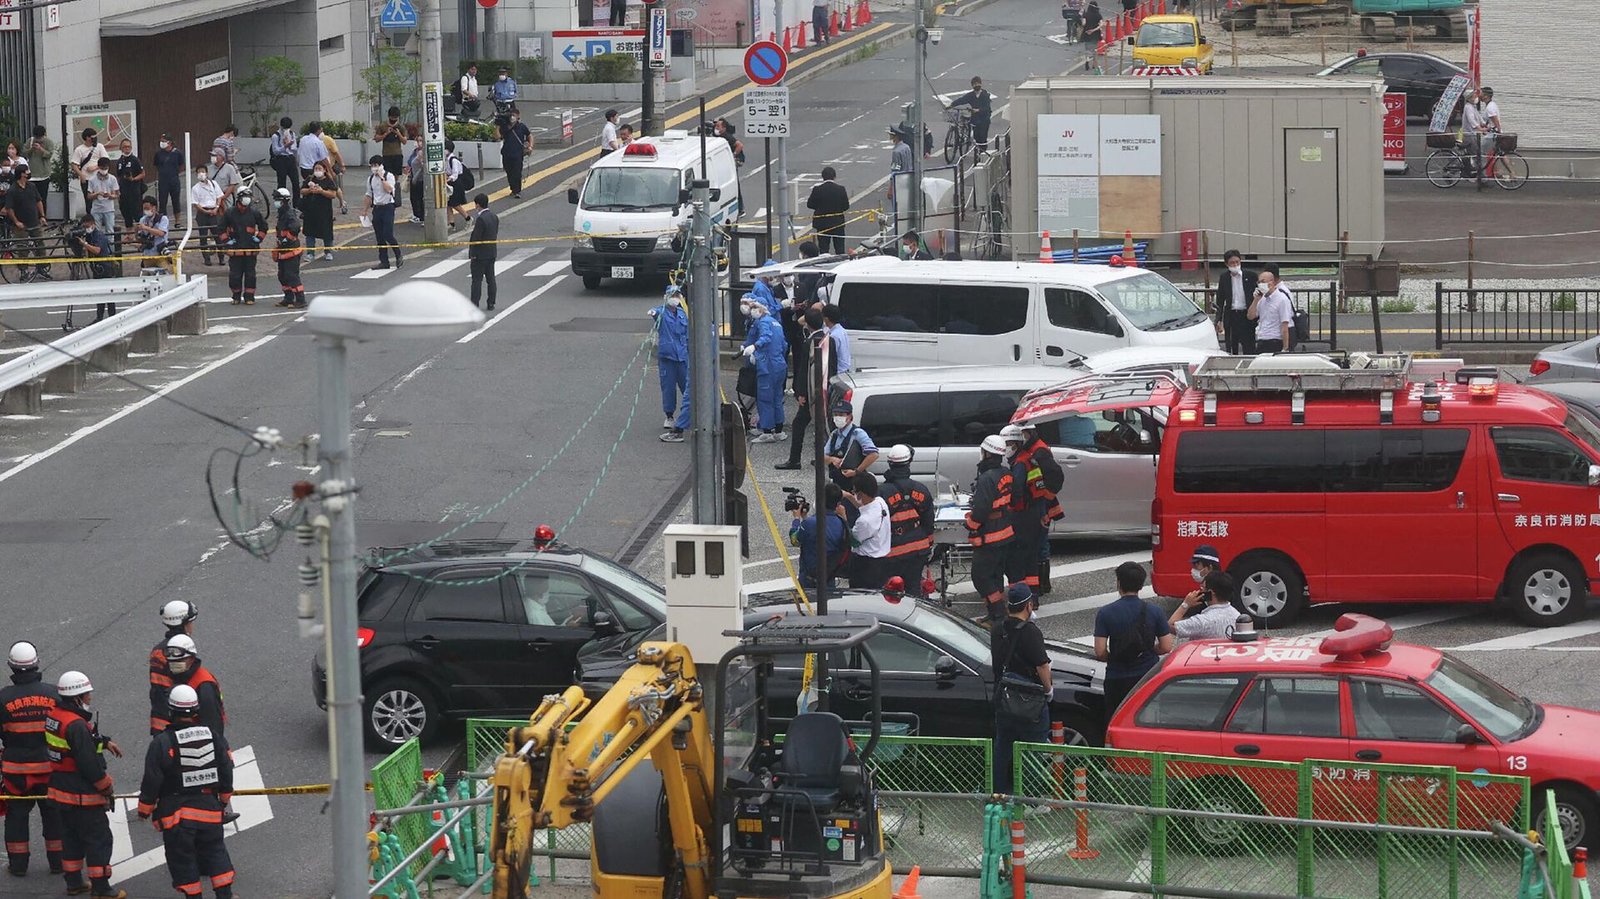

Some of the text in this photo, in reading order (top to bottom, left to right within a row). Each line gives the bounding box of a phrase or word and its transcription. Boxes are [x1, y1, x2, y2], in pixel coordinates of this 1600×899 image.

[592, 44, 606, 57] P
[747, 123, 787, 134] ここから
[1062, 130, 1074, 138] JV
[1514, 513, 1600, 527] 奈良市消防局
[1177, 520, 1229, 537] 指揮支援隊
[5, 695, 57, 712] 奈良市消防局
[1507, 755, 1527, 771] 13
[184, 771, 217, 783] 西大寺分署
